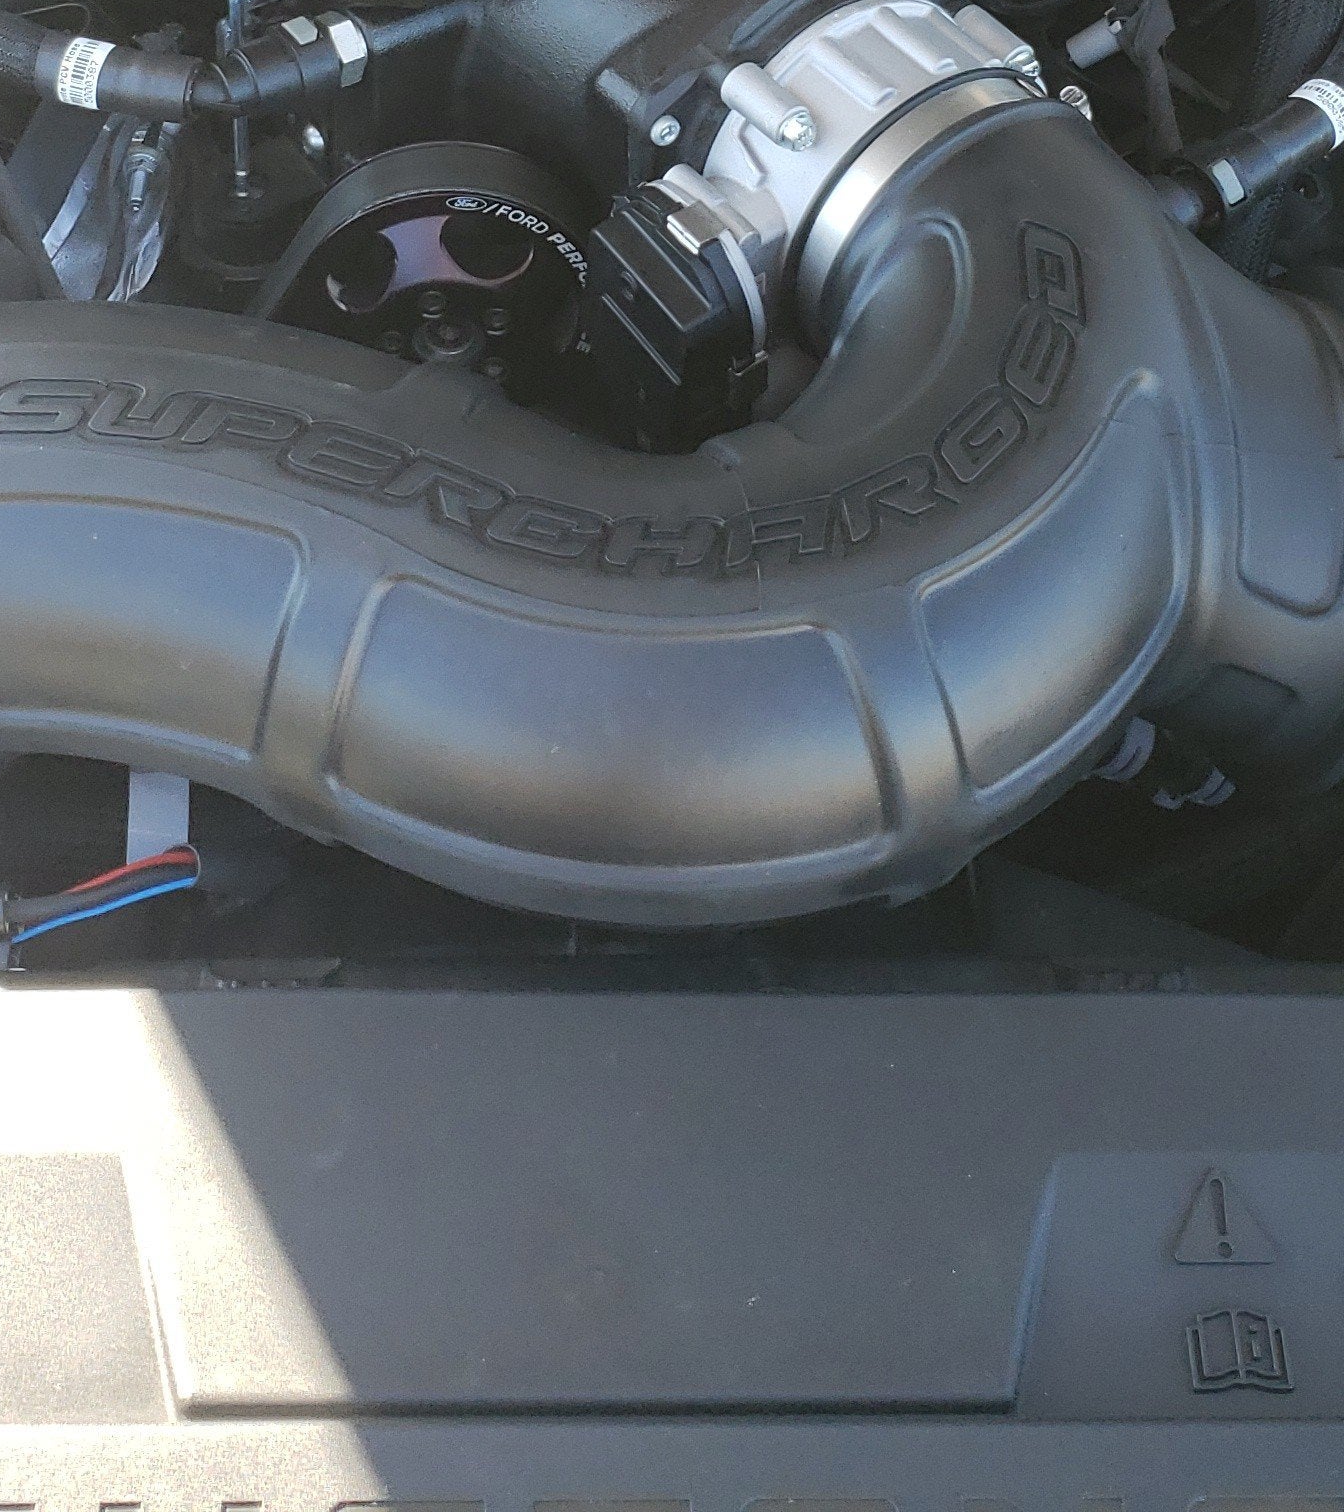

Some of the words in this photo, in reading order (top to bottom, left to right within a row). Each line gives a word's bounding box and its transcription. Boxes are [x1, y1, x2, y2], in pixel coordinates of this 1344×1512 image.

[59, 65, 69, 85] PCV
[65, 43, 81, 62] Hose
[495, 205, 549, 234] FORD
